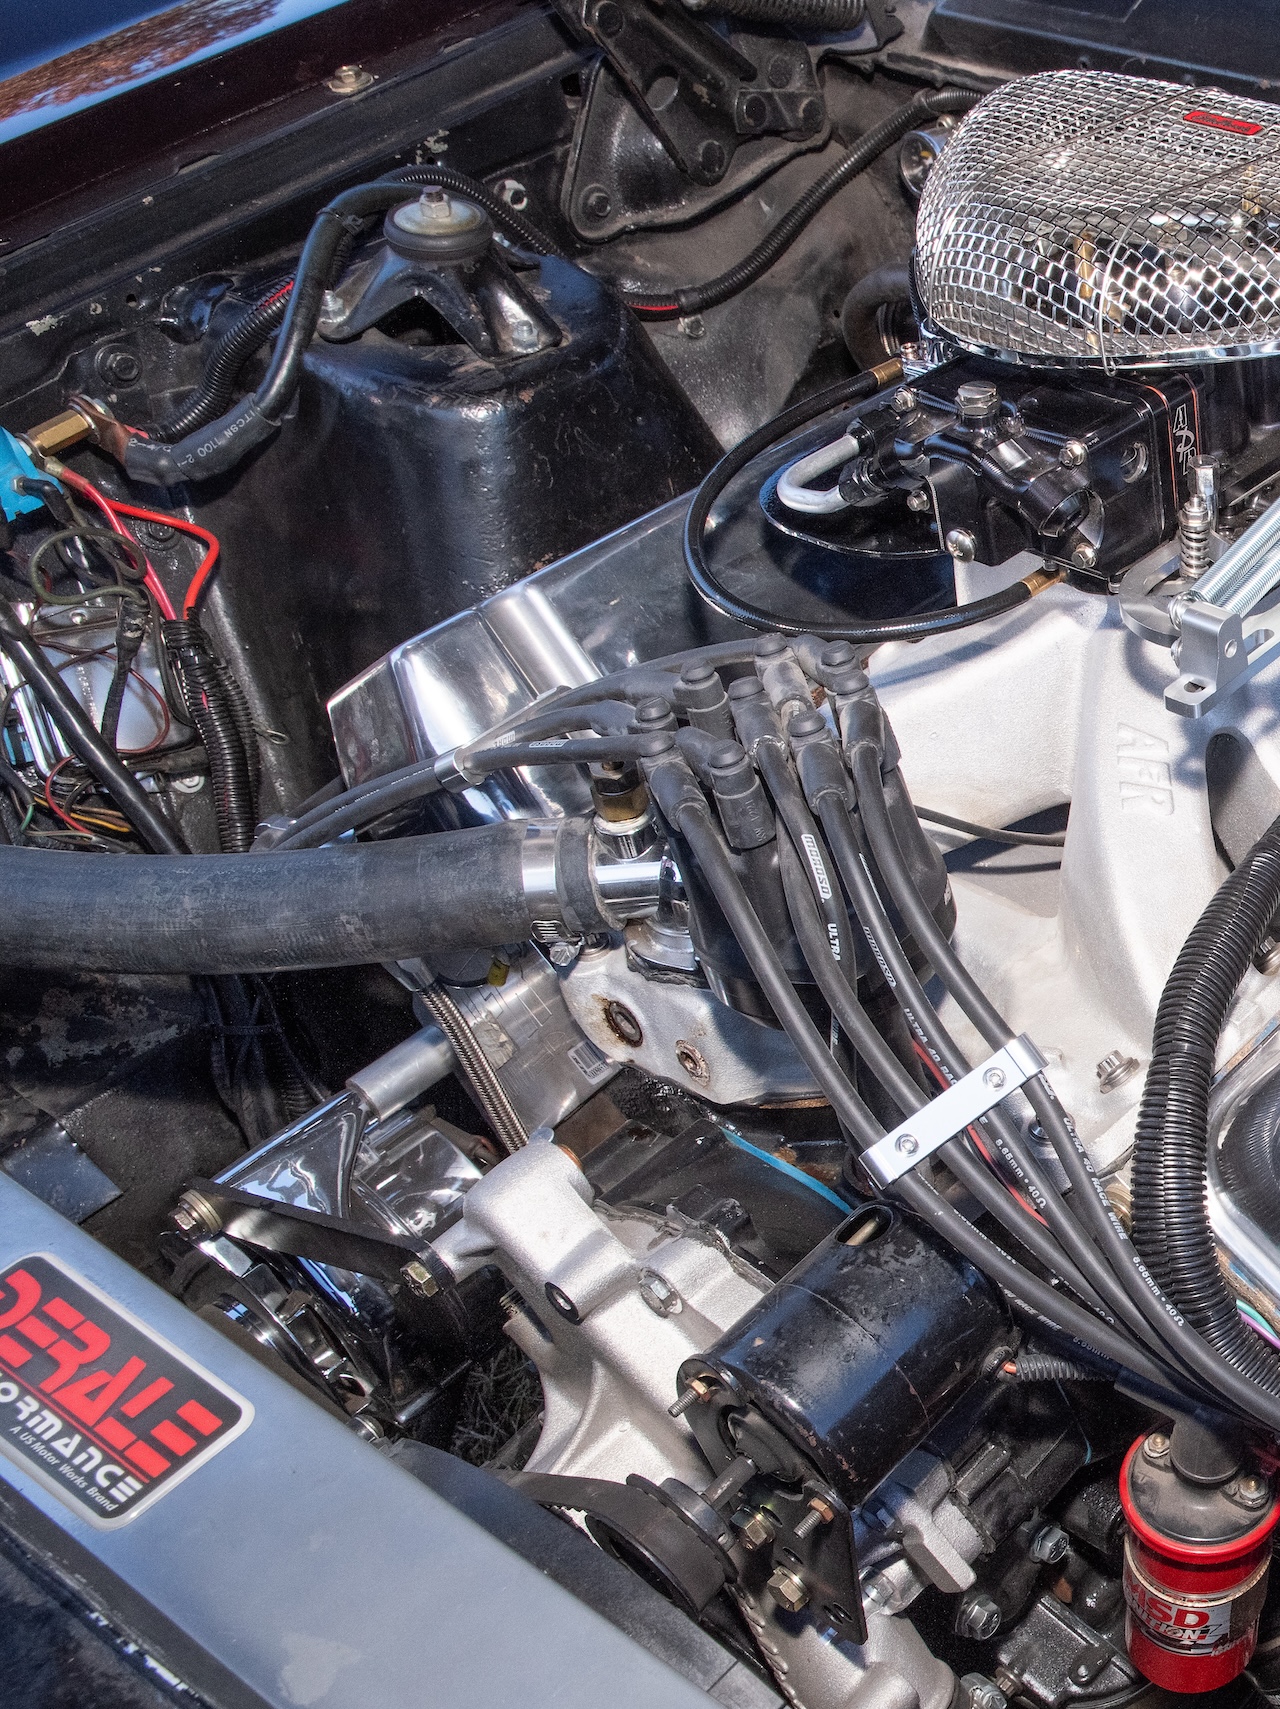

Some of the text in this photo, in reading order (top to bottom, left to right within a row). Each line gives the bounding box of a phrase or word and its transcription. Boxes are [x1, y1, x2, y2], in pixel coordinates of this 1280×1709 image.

[197, 437, 223, 458] 1100
[1116, 722, 1175, 816] AFR
[801, 834, 841, 961] MOROSO ULTRA
[904, 1008, 928, 1044] ULTRA
[929, 1048, 941, 1063] 40
[1063, 1116, 1085, 1153] ULTRA
[1083, 1157, 1094, 1173] 40
[1092, 1177, 1109, 1207] RACE
[1108, 1211, 1128, 1240] WIRE
[0, 1372, 143, 1502] ORMANCE
[10, 1425, 118, 1511] A US Motor Works Brand
